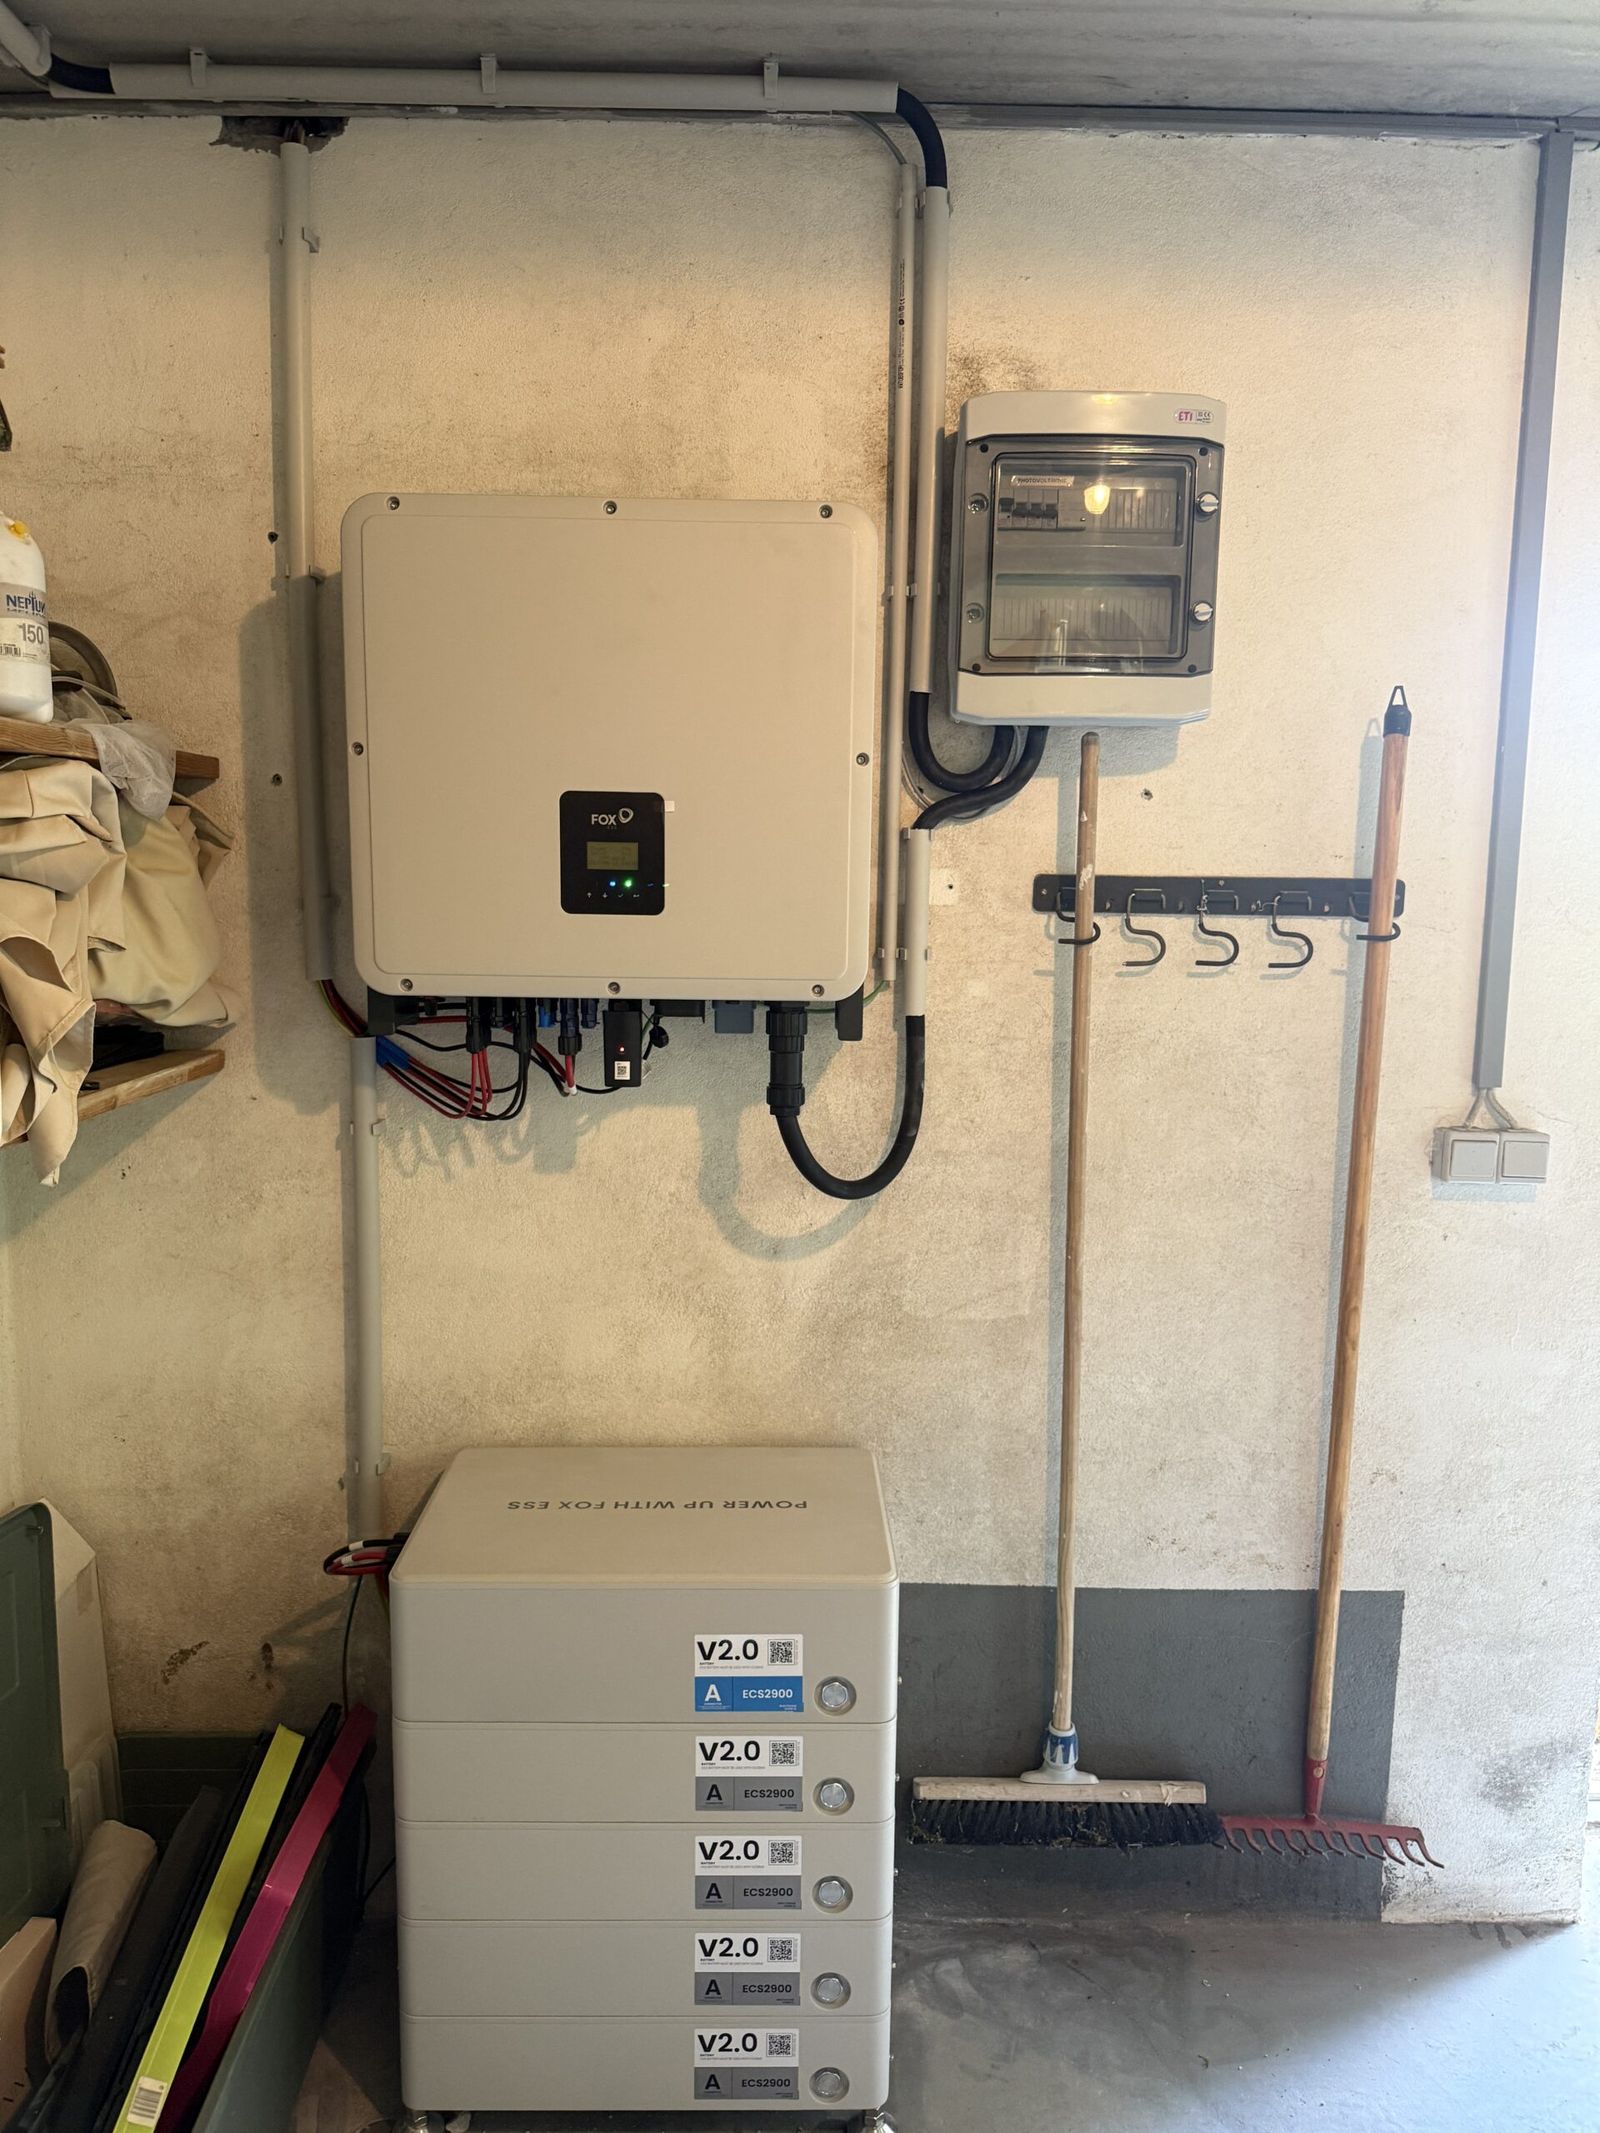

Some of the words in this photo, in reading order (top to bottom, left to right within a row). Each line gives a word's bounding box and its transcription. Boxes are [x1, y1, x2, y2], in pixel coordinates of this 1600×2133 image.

[1179, 412, 1192, 421] ETI
[18, 622, 44, 645] 150
[592, 814, 616, 825] FOX
[614, 1501, 674, 1509] WITH
[696, 1639, 759, 1660] V2.0
[704, 1684, 722, 1701] A
[742, 1689, 794, 1698] ECS2900
[698, 1741, 761, 1761] V2.0
[706, 1784, 723, 1800] A
[744, 1789, 795, 1798] ECS2900
[698, 1840, 760, 1860] V2.0
[705, 1883, 722, 1899] A
[743, 1888, 794, 1896] ECS2900
[697, 1938, 759, 1957] V2.0
[704, 1980, 722, 1995] A
[742, 1985, 792, 1993] ECS2900
[697, 2033, 758, 2052] V2.0
[704, 2074, 721, 2089] A
[741, 2079, 791, 2087] ECS2900
